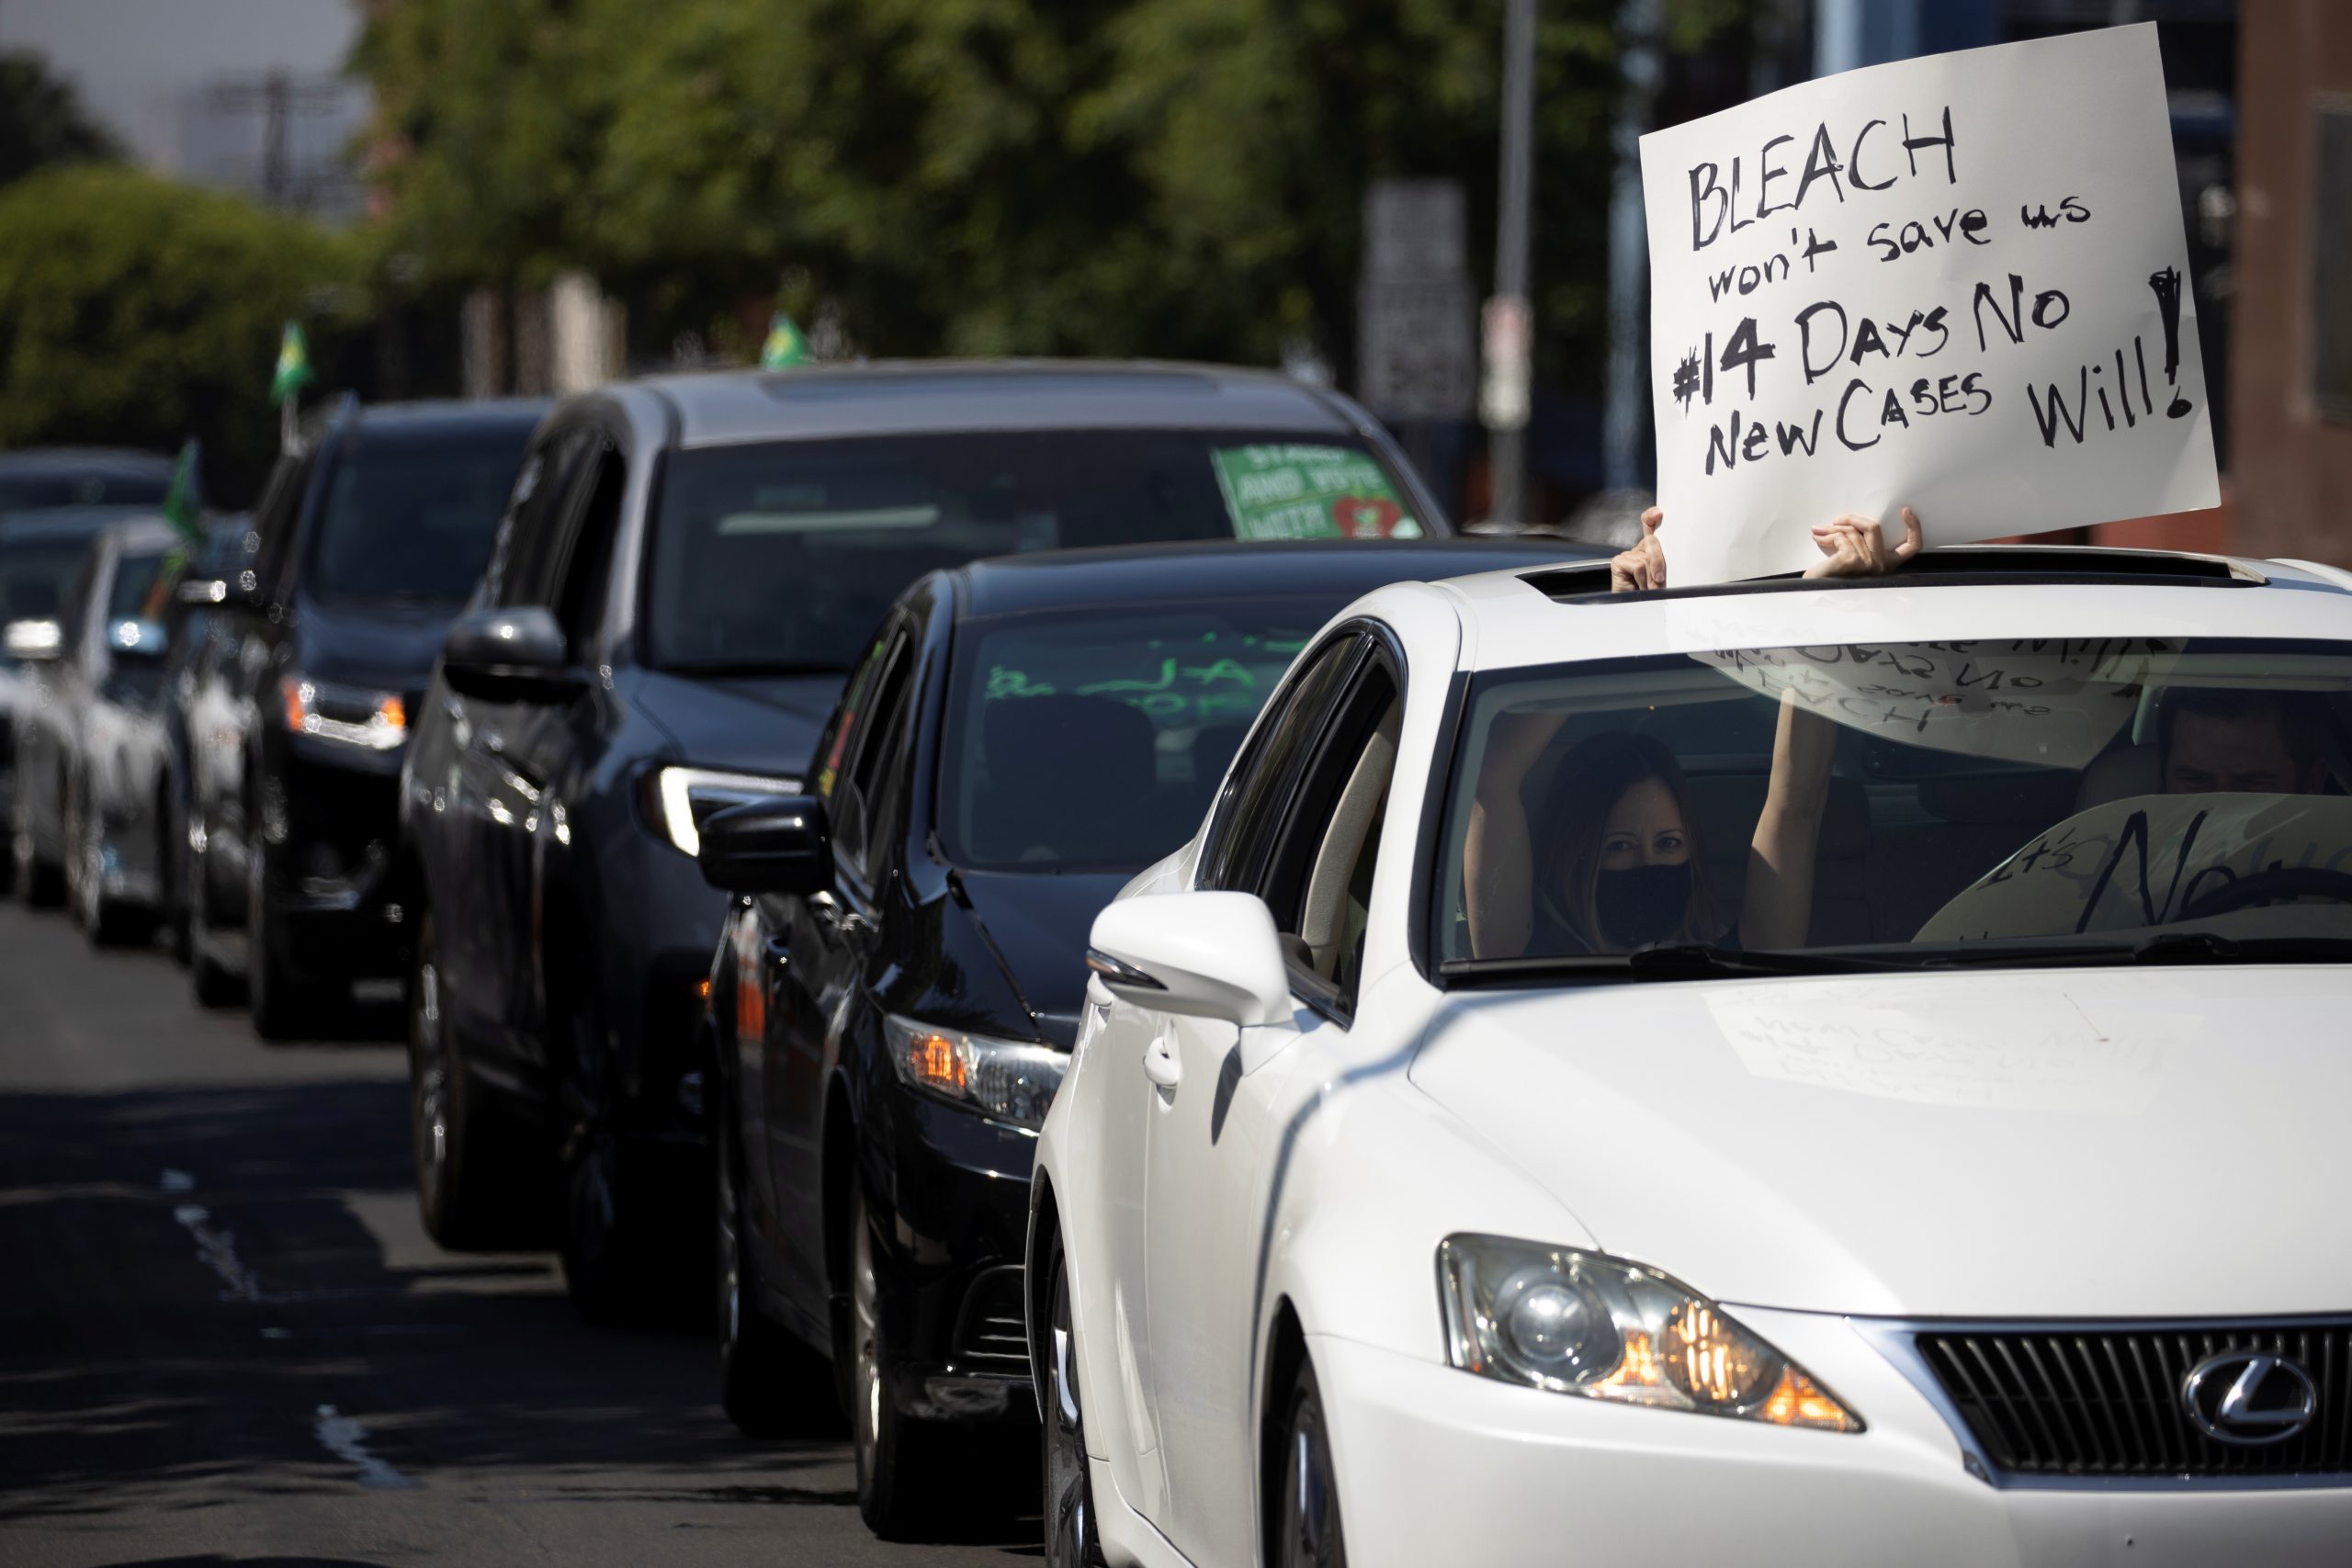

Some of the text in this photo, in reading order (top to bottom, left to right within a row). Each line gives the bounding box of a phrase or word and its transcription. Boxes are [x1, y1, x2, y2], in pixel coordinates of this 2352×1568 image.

[1689, 106, 1957, 252] BLEACH
[1708, 197, 2091, 304] won't save us
[1673, 317, 1775, 416] #14
[1837, 373, 1992, 451] CASES
